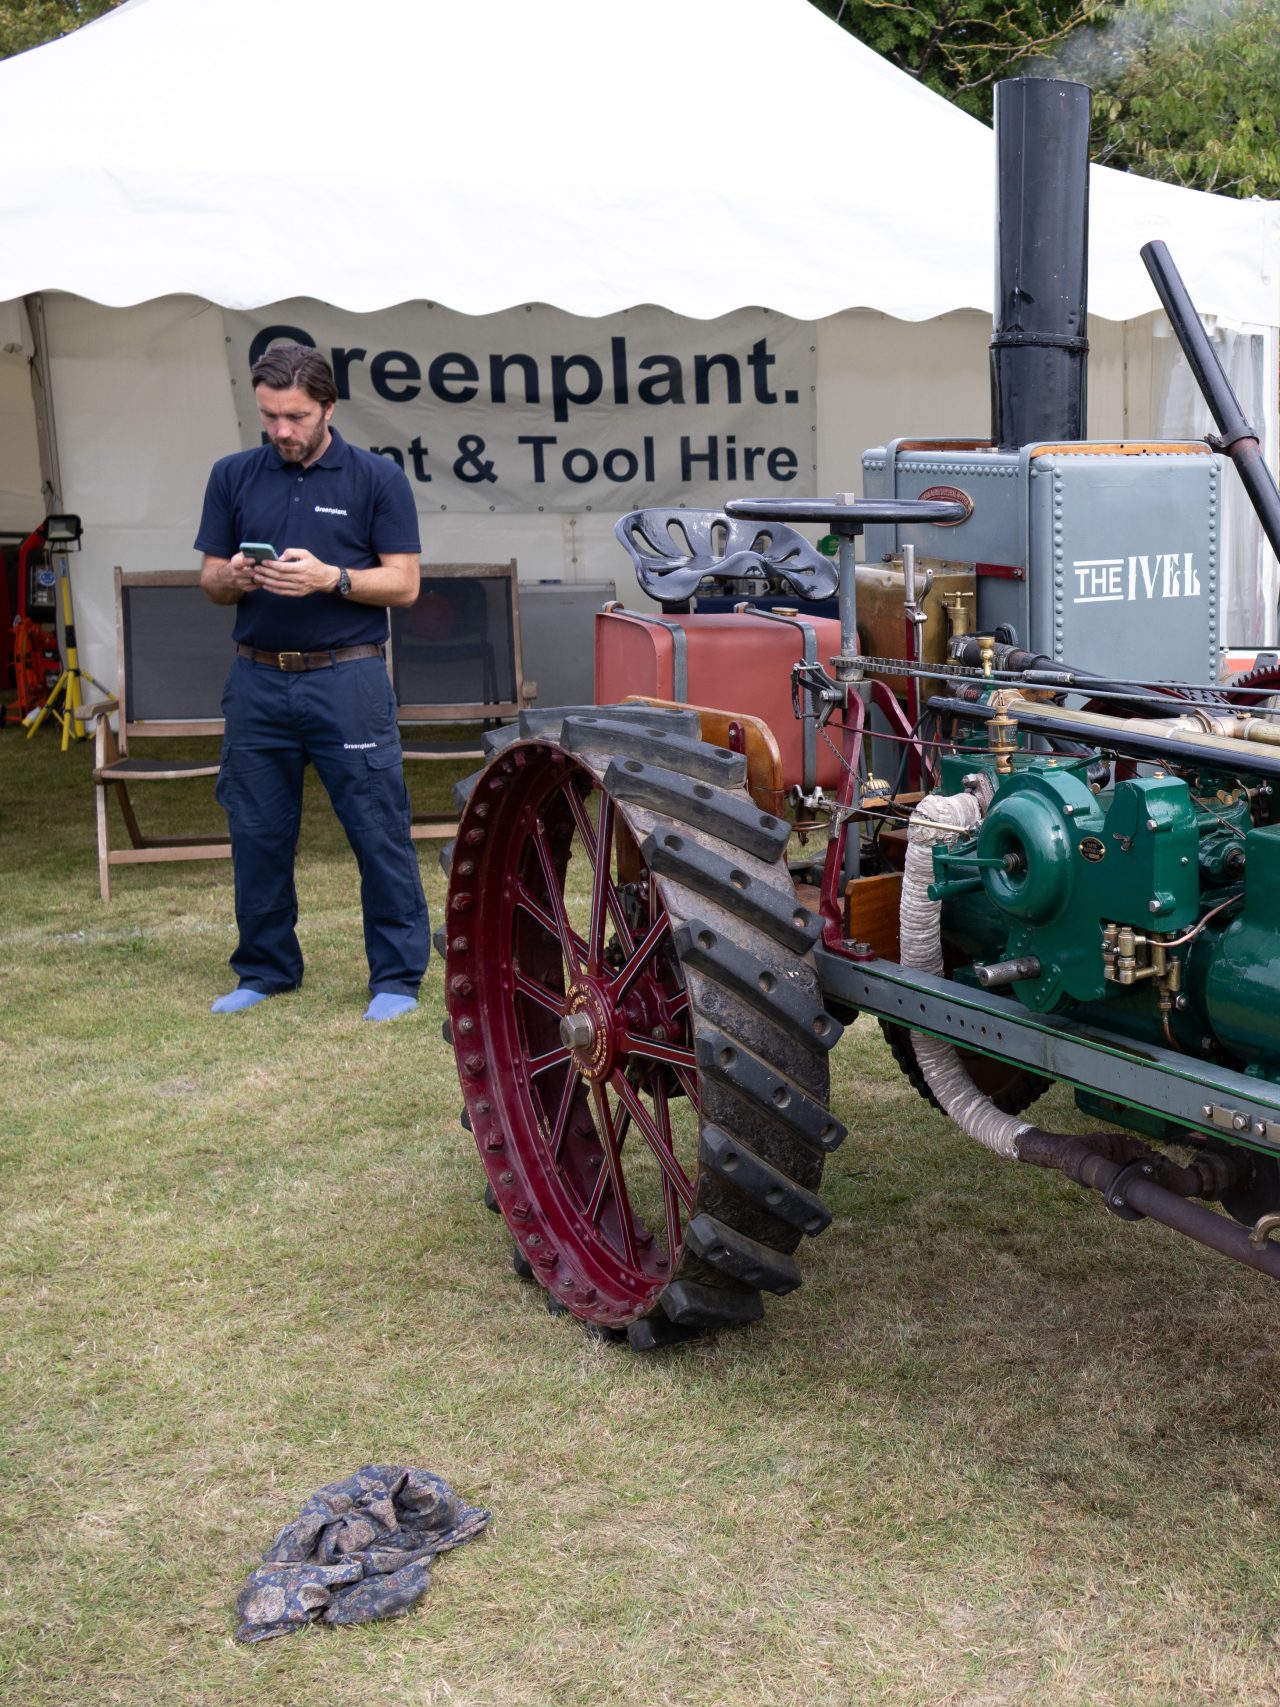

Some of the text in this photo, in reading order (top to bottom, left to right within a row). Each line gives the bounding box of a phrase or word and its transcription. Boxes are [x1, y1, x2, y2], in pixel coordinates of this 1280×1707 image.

[453, 434, 498, 482] &
[518, 436, 655, 483] Tool
[680, 435, 798, 482] Hire
[1074, 553, 1201, 601] THE IVEL
